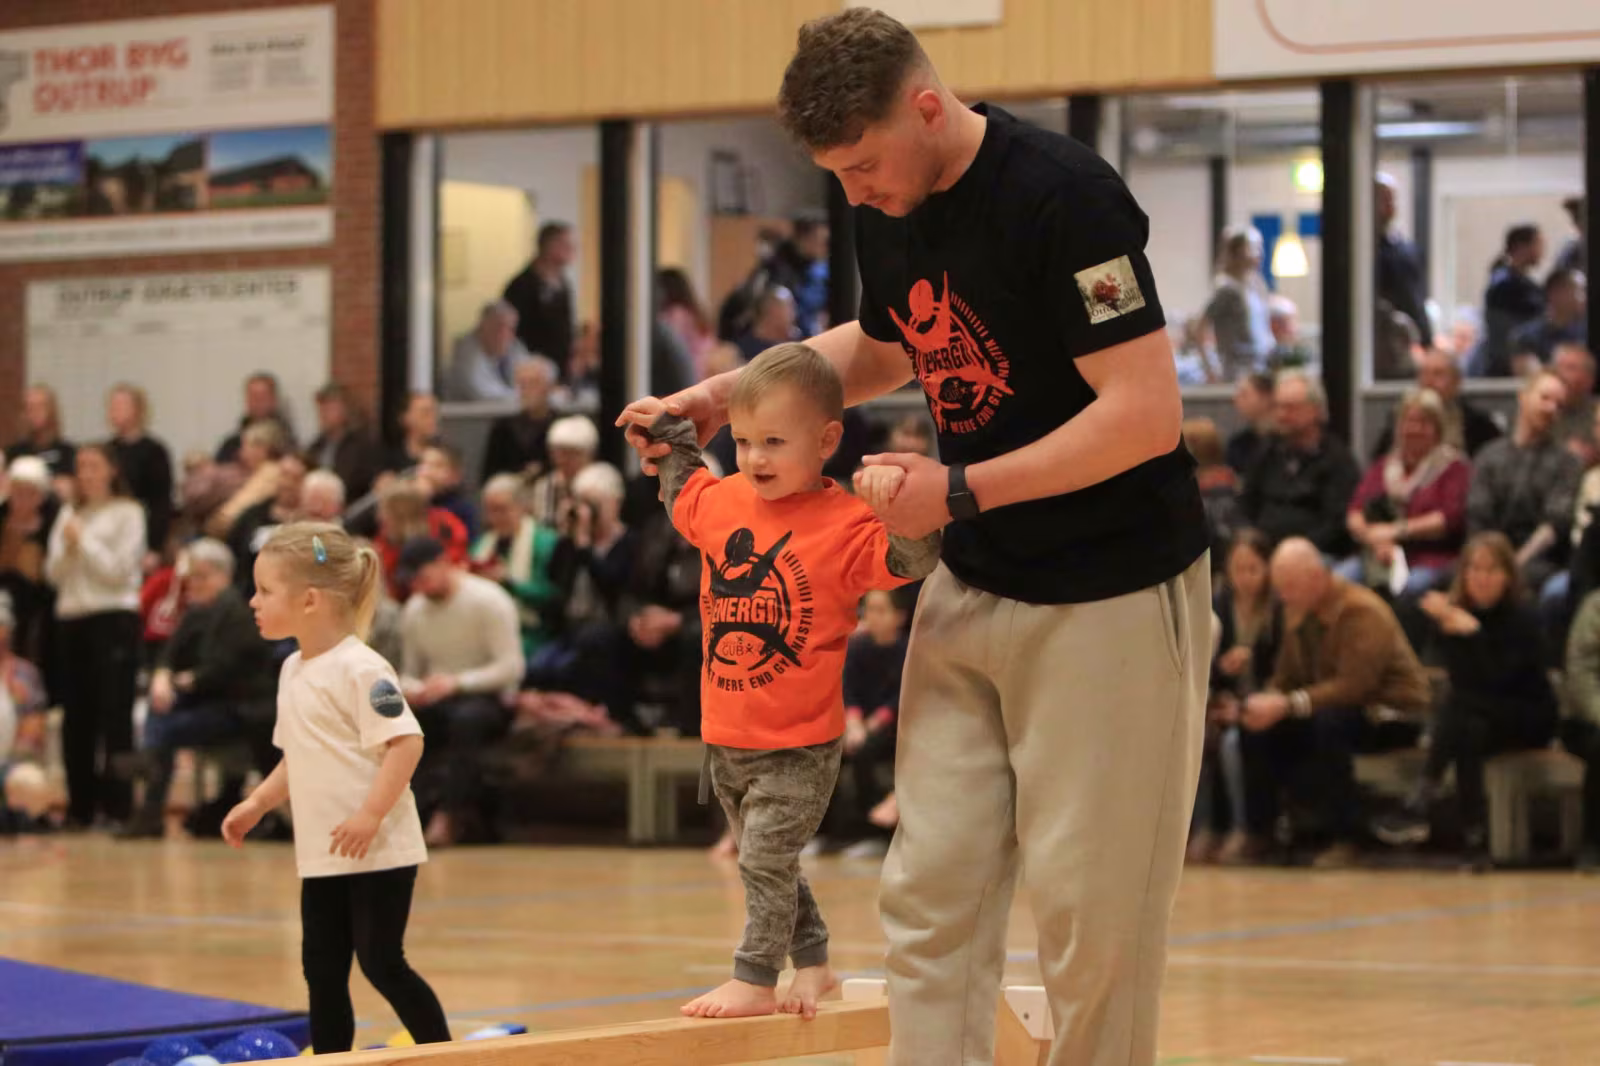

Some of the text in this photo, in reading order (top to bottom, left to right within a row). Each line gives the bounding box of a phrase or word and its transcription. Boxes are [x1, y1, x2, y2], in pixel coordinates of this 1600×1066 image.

[34, 43, 116, 74] THOR
[127, 37, 189, 70] BYG
[34, 76, 156, 113] OUTRUP
[716, 676, 745, 692] MERE
[749, 671, 774, 689] END
